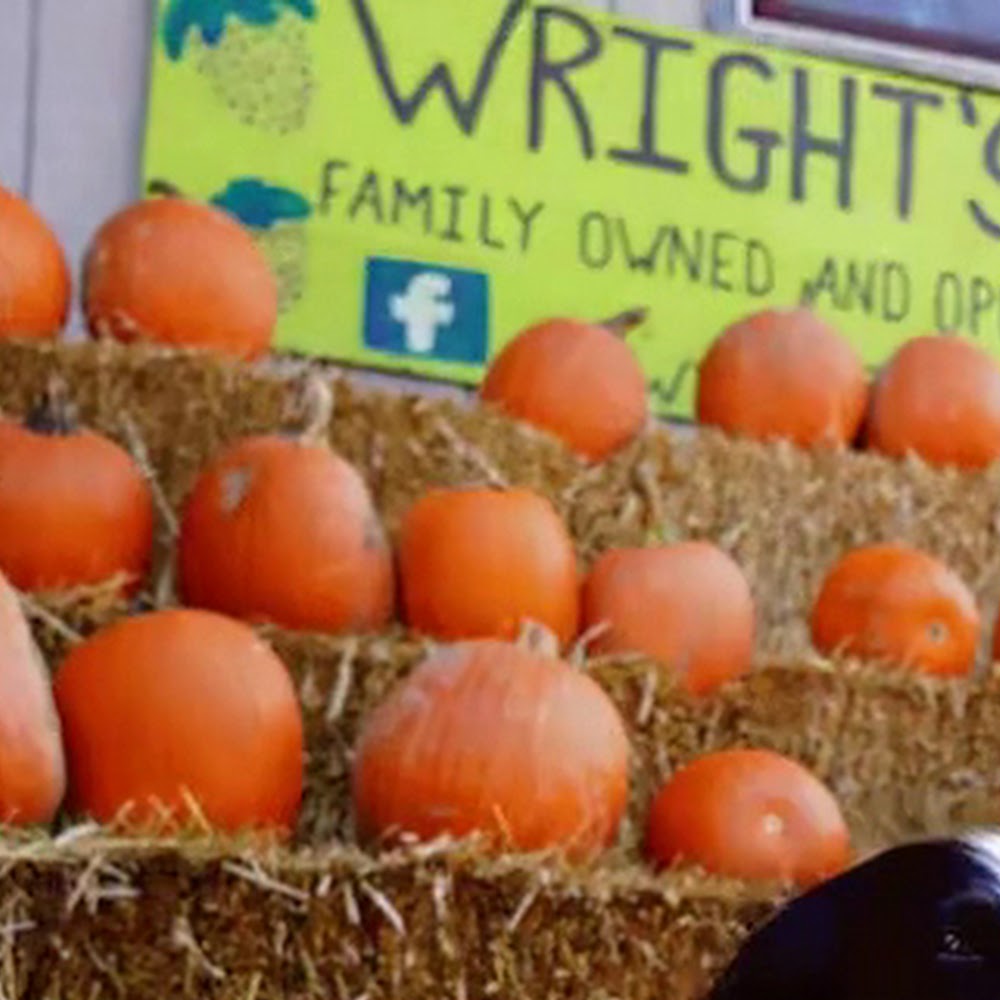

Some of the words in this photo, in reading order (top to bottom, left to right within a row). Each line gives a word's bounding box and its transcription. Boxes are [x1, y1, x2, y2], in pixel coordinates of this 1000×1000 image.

[320, 160, 544, 250] FAMILY
[579, 211, 775, 297] OWNED
[812, 257, 911, 322] AND
